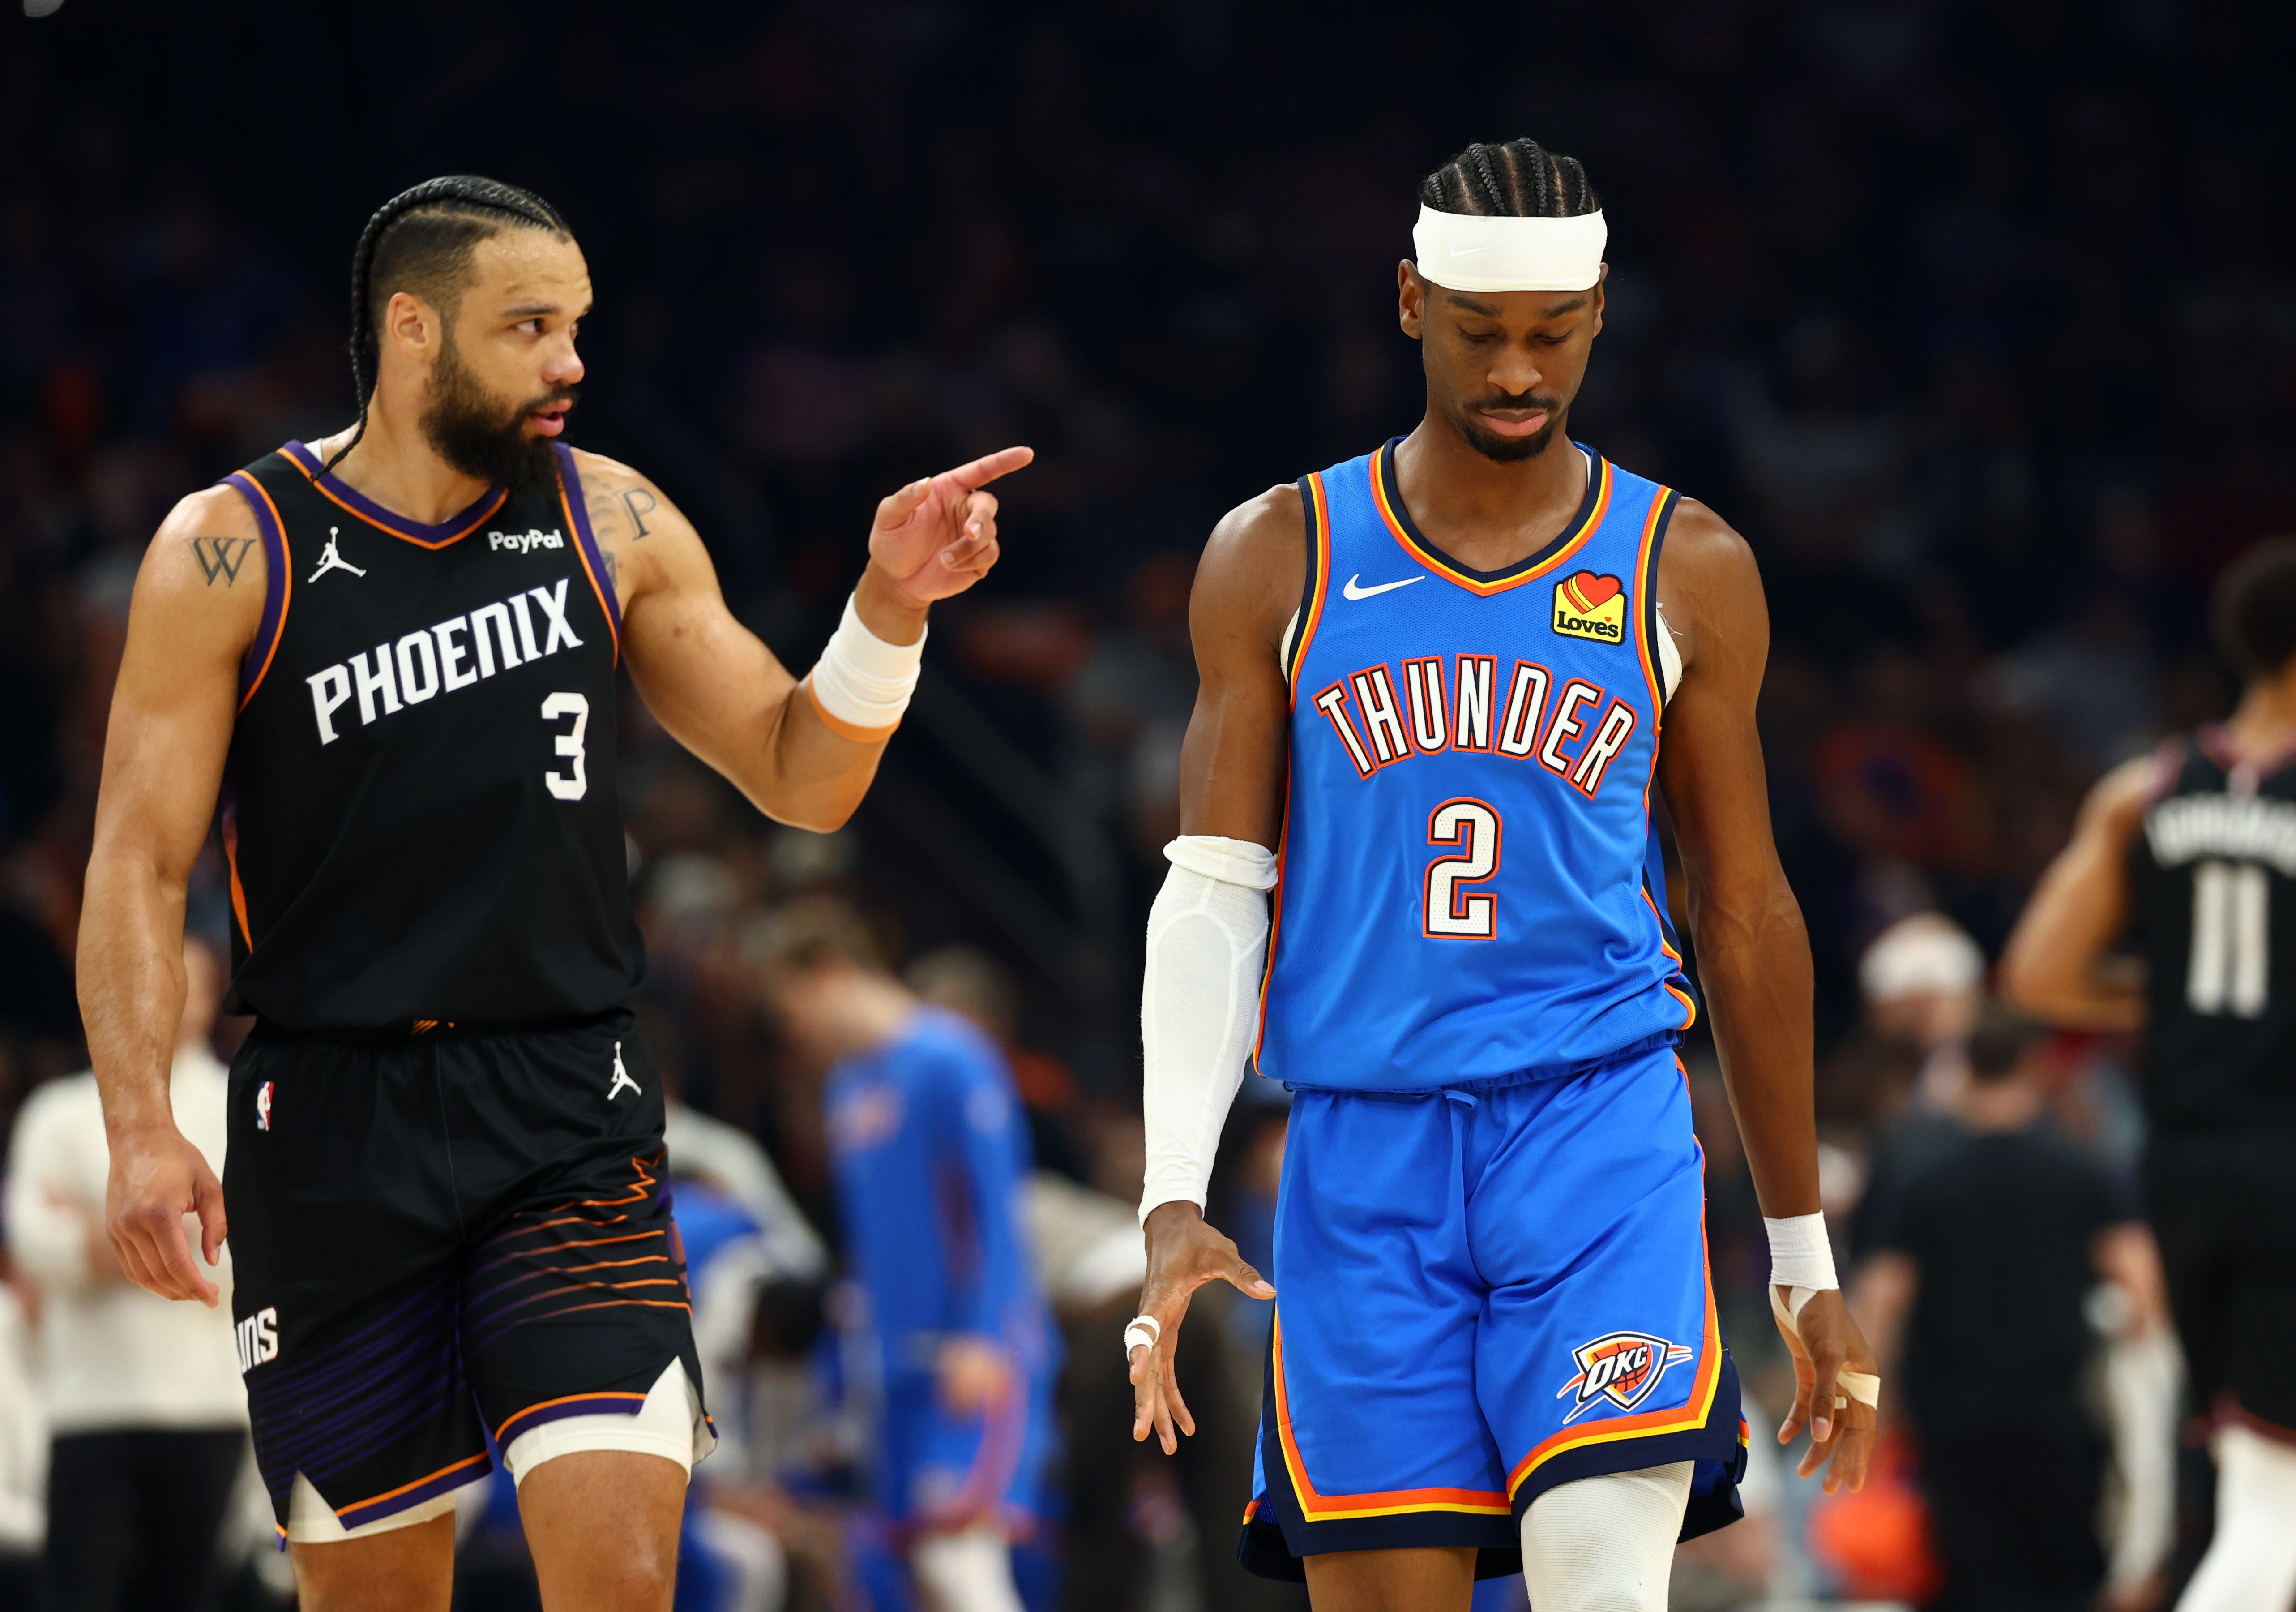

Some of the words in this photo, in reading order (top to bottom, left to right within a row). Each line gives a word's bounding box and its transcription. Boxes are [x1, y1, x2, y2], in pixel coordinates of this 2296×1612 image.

[185, 536, 257, 588] W
[488, 528, 564, 554] PayPal
[305, 577, 584, 746] PHOENIX
[541, 692, 589, 801] 3
[1311, 653, 1638, 801] THUNDER
[1423, 797, 1503, 940] 2
[2187, 857, 2270, 1017] 11
[237, 1307, 278, 1375] UNS
[1582, 1346, 1649, 1398] OKC
